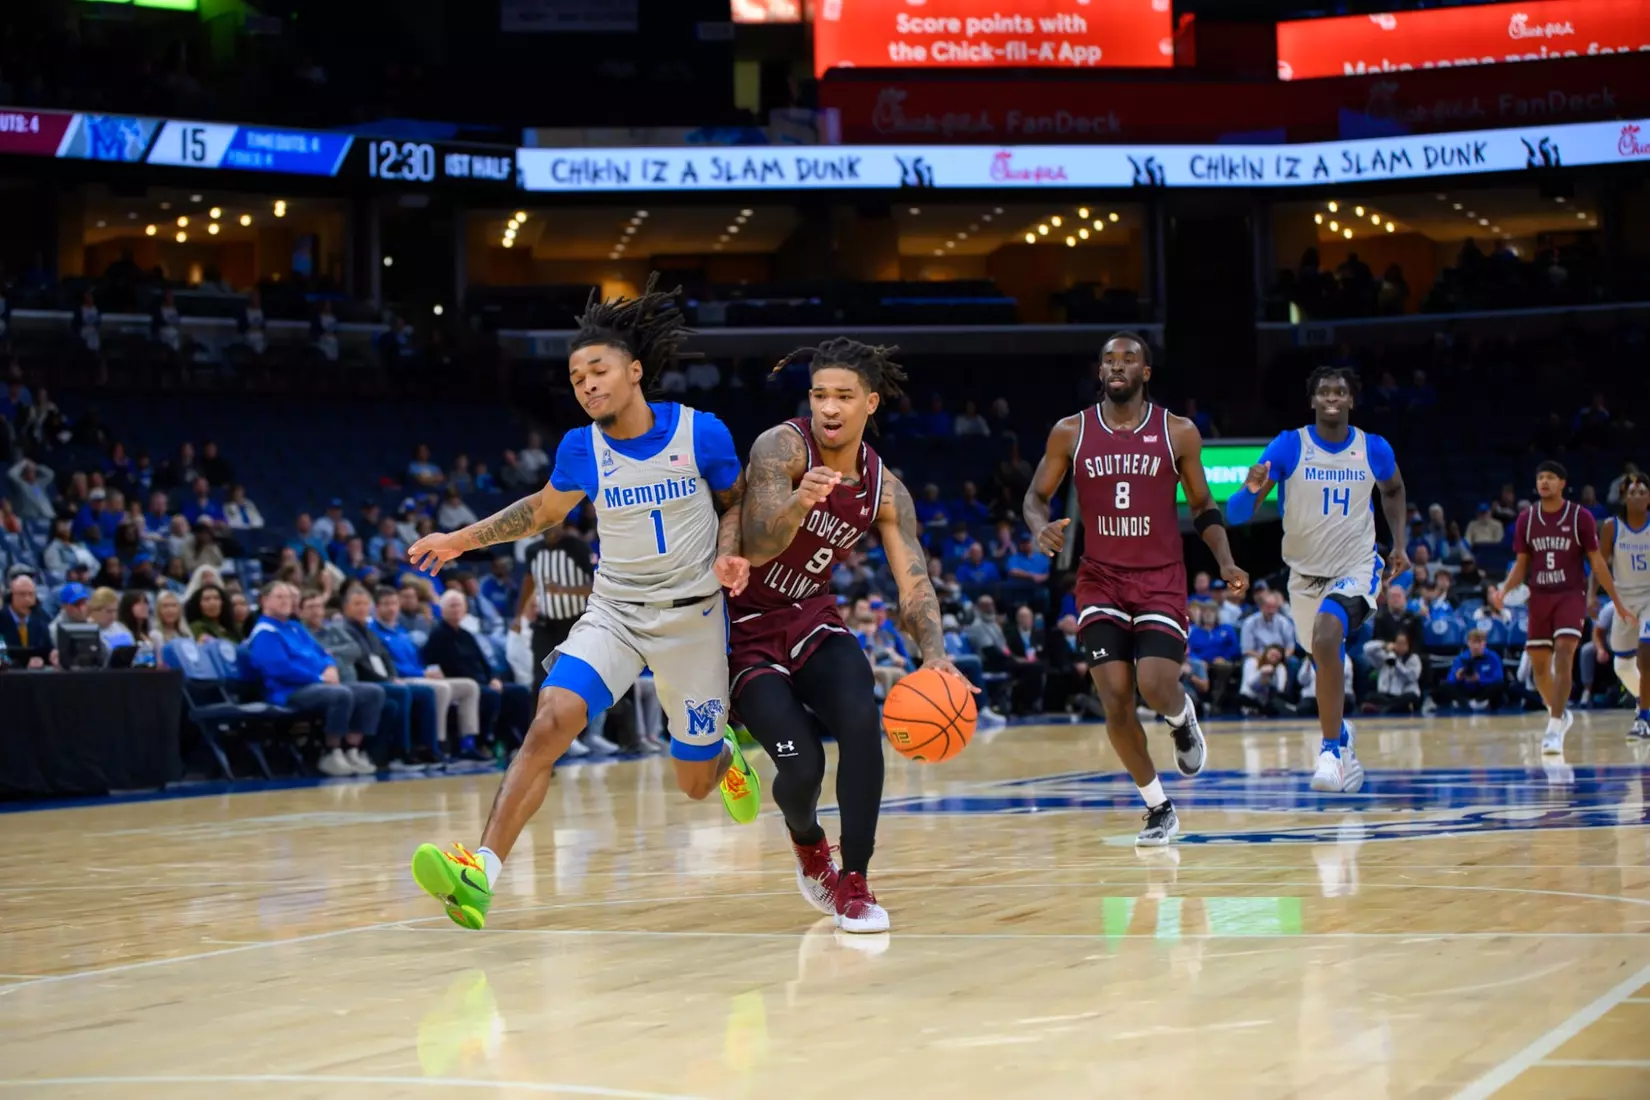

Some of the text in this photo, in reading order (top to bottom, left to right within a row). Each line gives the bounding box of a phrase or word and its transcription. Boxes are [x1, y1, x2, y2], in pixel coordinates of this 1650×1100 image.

[896, 13, 1087, 37] Score points with
[888, 41, 927, 61] the
[1059, 41, 1102, 66] App
[182, 128, 206, 162] 15
[369, 140, 435, 182] 12:30
[472, 155, 511, 180] HALF
[552, 155, 862, 184] CHIKIN IZ A SLAM DUNK
[1190, 140, 1487, 181] CHIKIN IZ A SLAM DUNK
[1084, 453, 1161, 478] SOUTHERN
[1304, 466, 1366, 483] Memphis
[604, 476, 698, 509] Memphis
[1115, 481, 1130, 509] 8
[1322, 487, 1351, 517] 14
[649, 509, 668, 555] 1
[1098, 515, 1150, 537] ILLINOIS
[1532, 536, 1571, 552] SOUTHERN
[805, 547, 834, 575] 9
[1546, 551, 1555, 570] 5
[1631, 553, 1647, 571] 15
[1536, 569, 1566, 585] ILLINOIS
